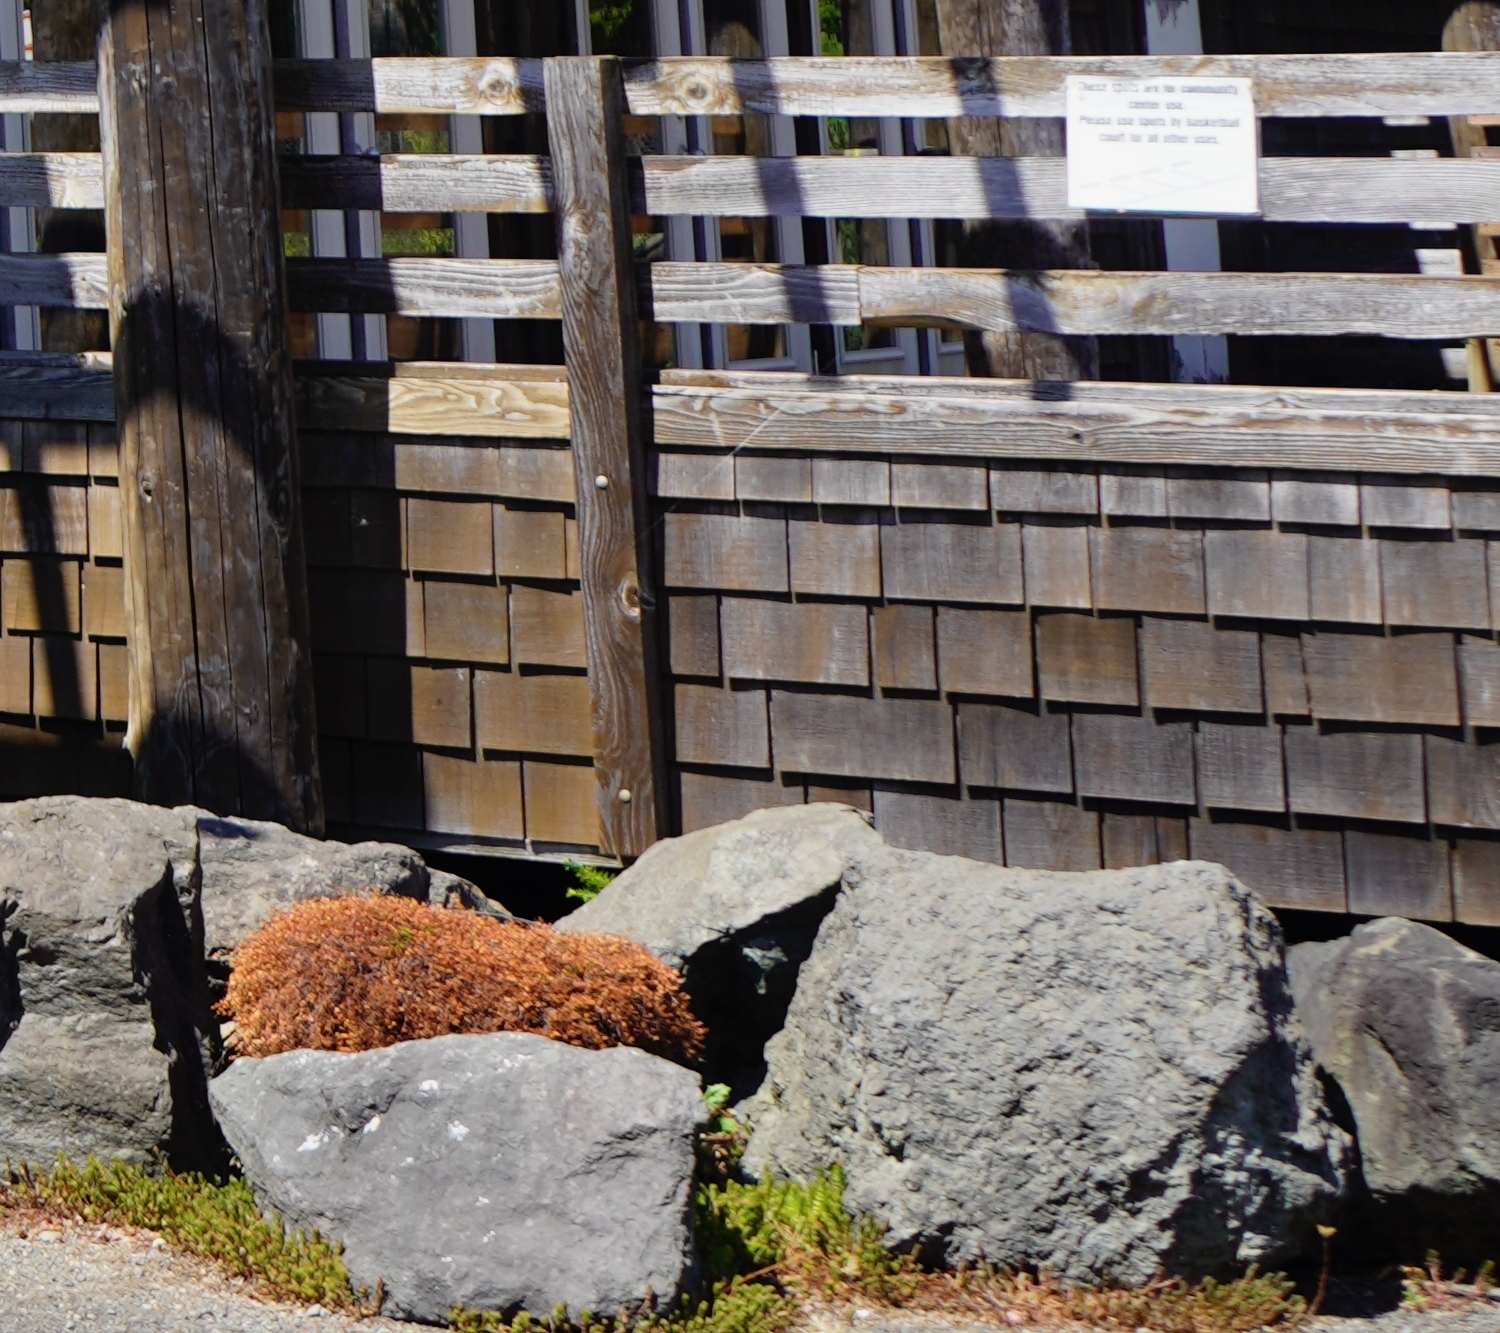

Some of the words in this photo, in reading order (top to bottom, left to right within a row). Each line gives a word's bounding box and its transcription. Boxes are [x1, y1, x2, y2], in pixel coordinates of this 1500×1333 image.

[1180, 84, 1238, 95] community
[1128, 100, 1160, 109] center
[1079, 115, 1112, 126] Please
[1117, 117, 1133, 126] use
[1171, 117, 1181, 128] by
[1186, 117, 1240, 128] basketball
[1164, 134, 1188, 144] other
